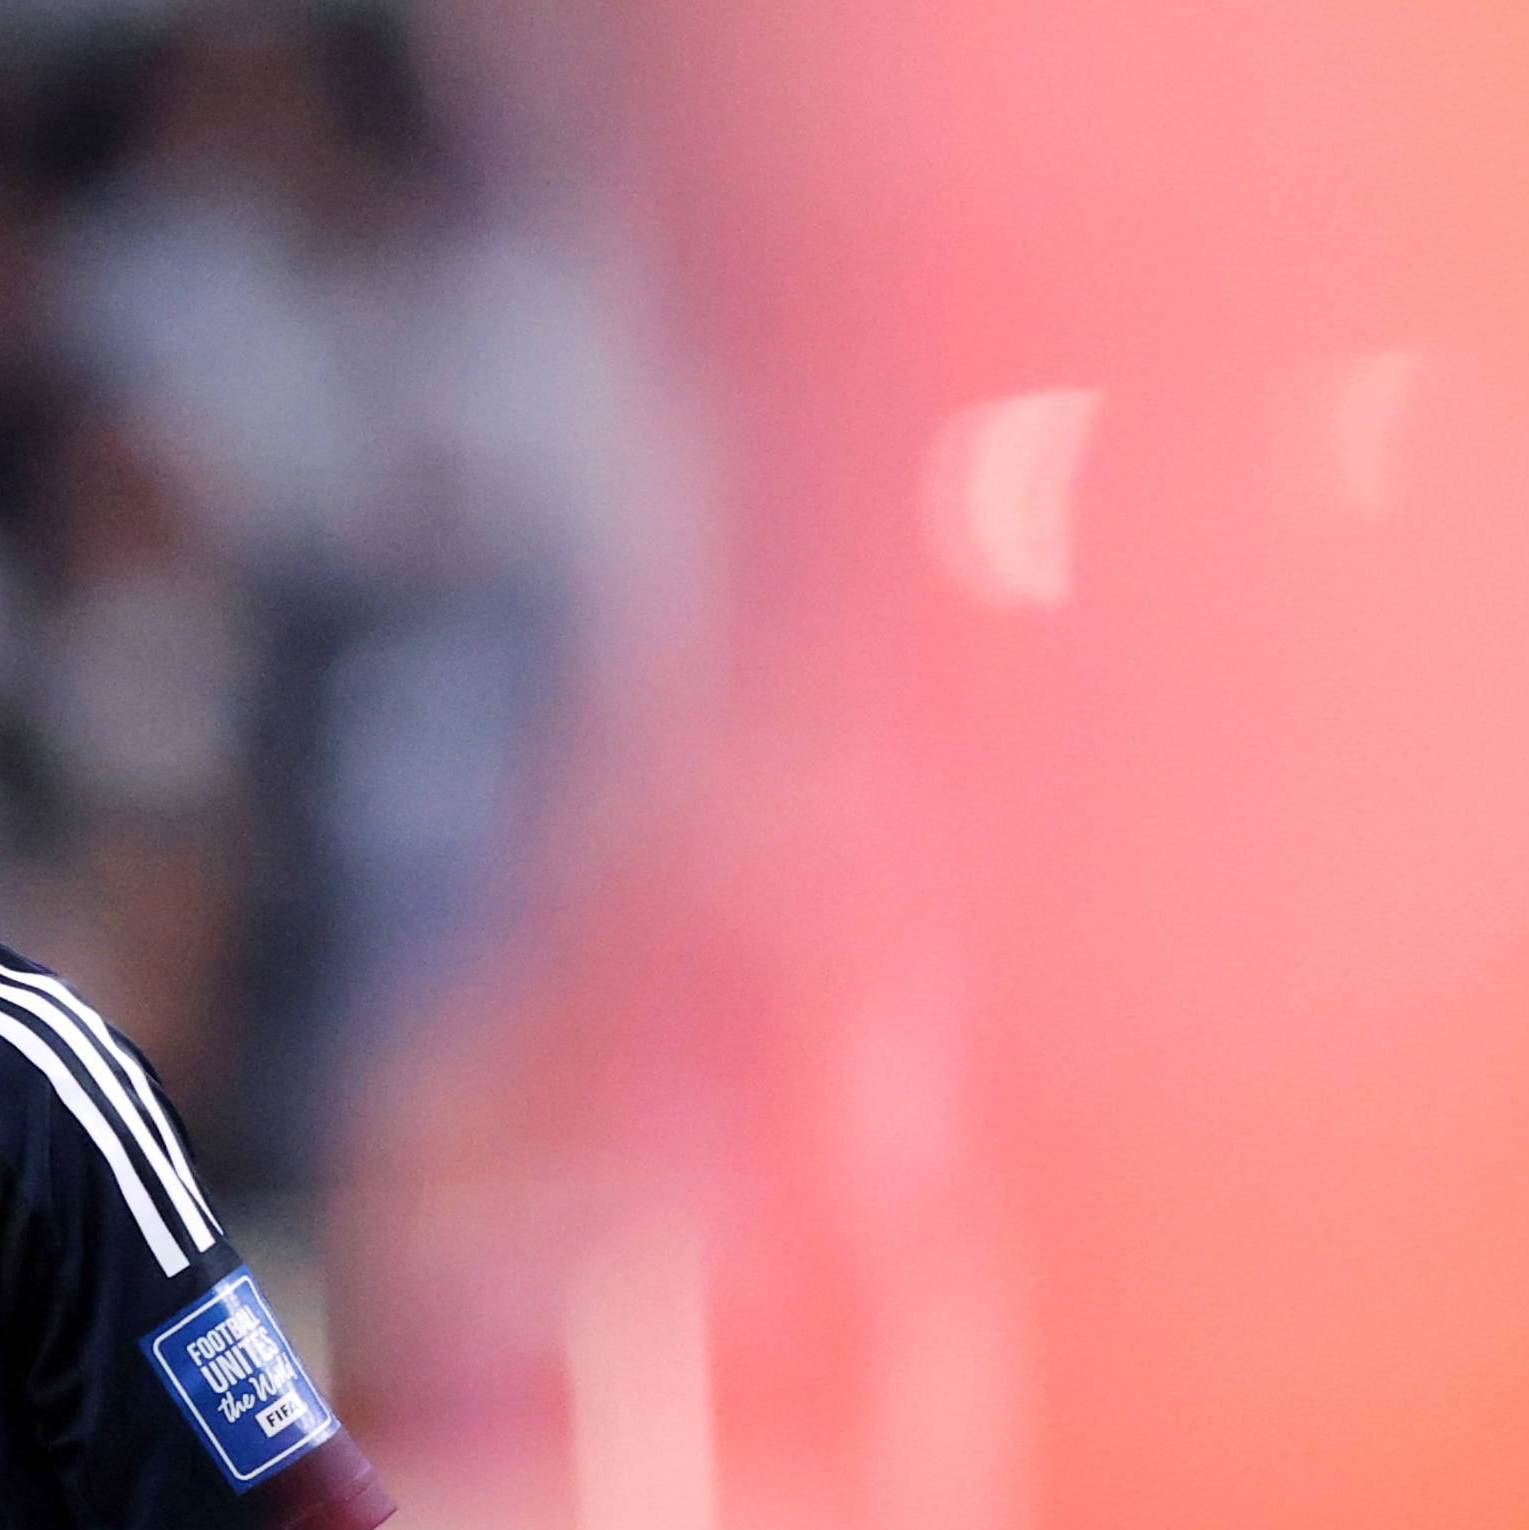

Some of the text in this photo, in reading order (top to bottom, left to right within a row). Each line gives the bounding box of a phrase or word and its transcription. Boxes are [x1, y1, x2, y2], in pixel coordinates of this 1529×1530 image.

[200, 1326, 280, 1394] UNITES
[217, 1391, 256, 1423] the
[266, 1400, 300, 1428] FIFA
